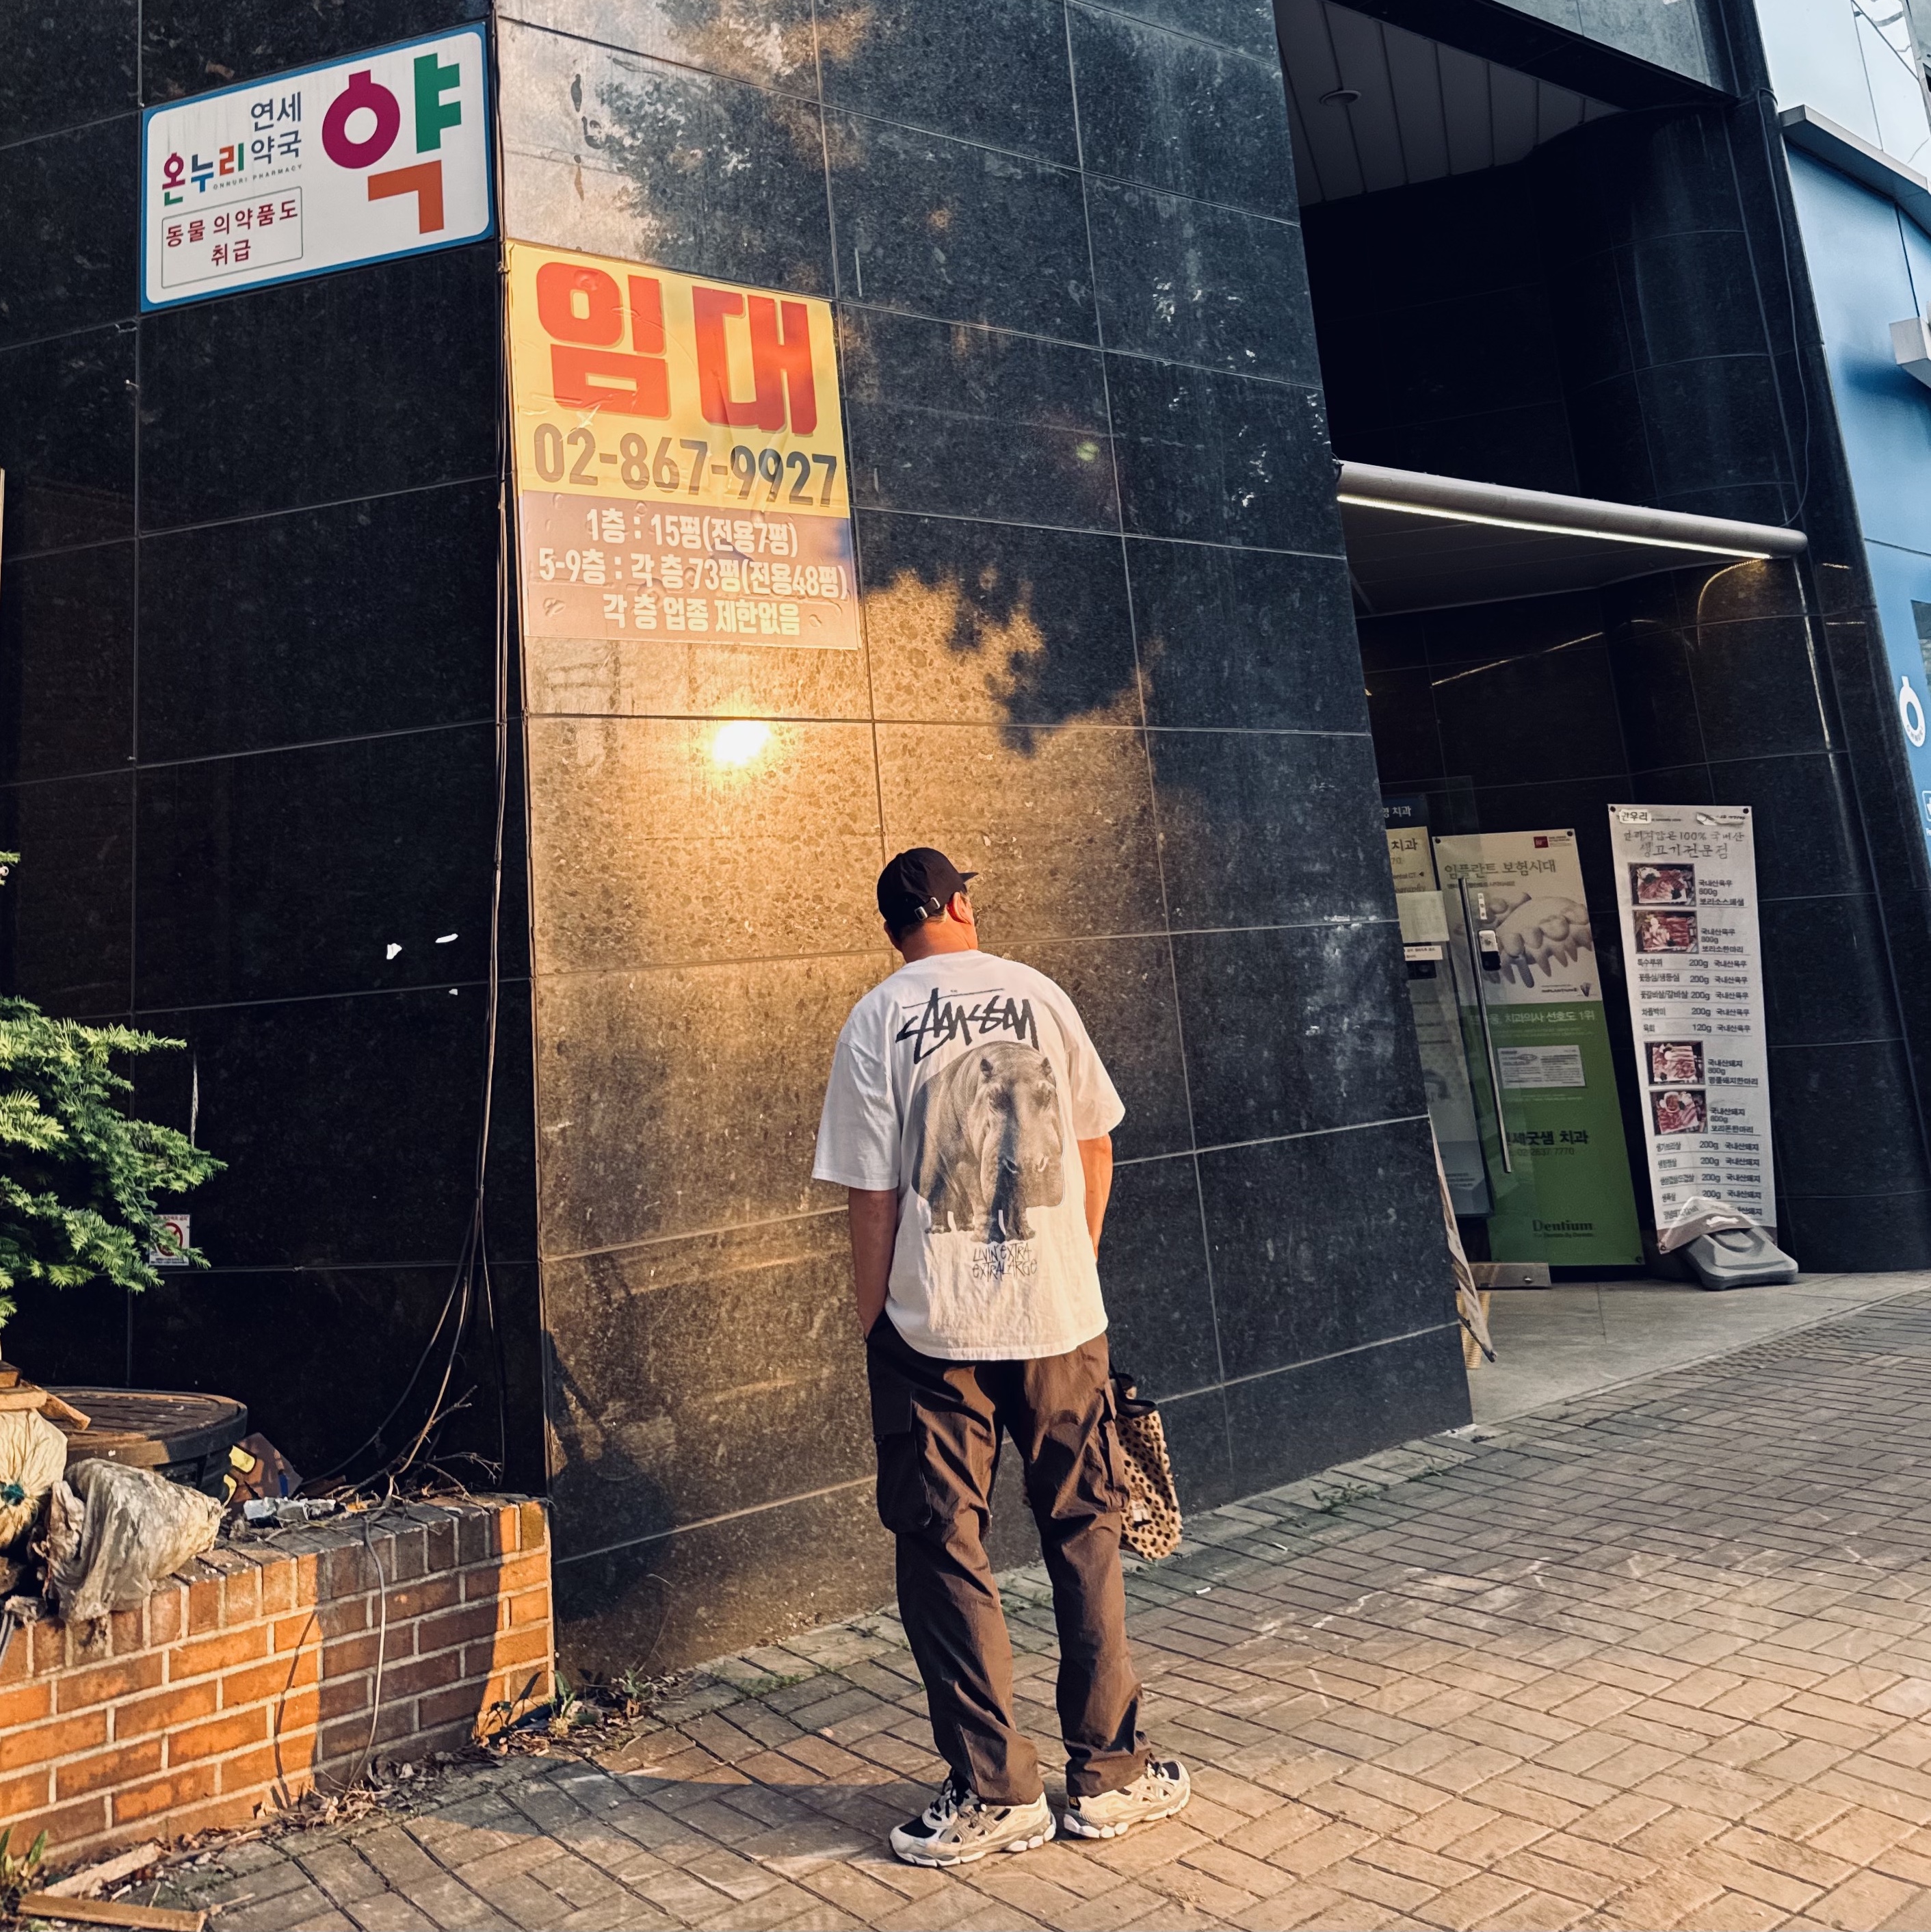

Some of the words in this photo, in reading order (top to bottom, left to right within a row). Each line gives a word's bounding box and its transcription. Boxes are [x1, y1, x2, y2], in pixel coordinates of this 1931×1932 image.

[251, 92, 302, 131] 연세
[322, 53, 461, 234] 약
[162, 143, 244, 206] 온누리
[251, 130, 302, 164] 약국
[213, 177, 248, 190] ONNURI
[252, 164, 302, 181] PHARMACY
[166, 219, 205, 247] 동물
[213, 199, 298, 235] 의약품도
[211, 239, 251, 267] 취급
[536, 262, 817, 436] 임대
[534, 423, 837, 508] 02-867-9927
[664, 595, 708, 631] 업종
[715, 599, 801, 636] 제한없음
[1393, 806, 1412, 818] 치과
[1680, 831, 1707, 841] 100%
[1391, 838, 1418, 852] 치과
[1640, 842, 1728, 859] 생고기전문점
[1444, 863, 1498, 879] 임플란트
[1502, 859, 1556, 876] 보험시대
[1689, 959, 1708, 968] 200g
[1690, 976, 1709, 984] 200g
[1691, 991, 1710, 1000] 200g
[1505, 1012, 1544, 1023] 치과의사
[1546, 1011, 1577, 1023] 선호도
[1579, 1010, 1595, 1021] 1위
[1692, 1008, 1711, 1017] 200g
[1692, 1024, 1711, 1033] 120g
[1559, 1130, 1589, 1145] 치과
[1699, 1141, 1719, 1150] 200g
[1700, 1157, 1720, 1166] 200g
[1702, 1173, 1720, 1182] 200g
[1702, 1190, 1721, 1199] 200g
[1532, 1220, 1593, 1231] Dentium
